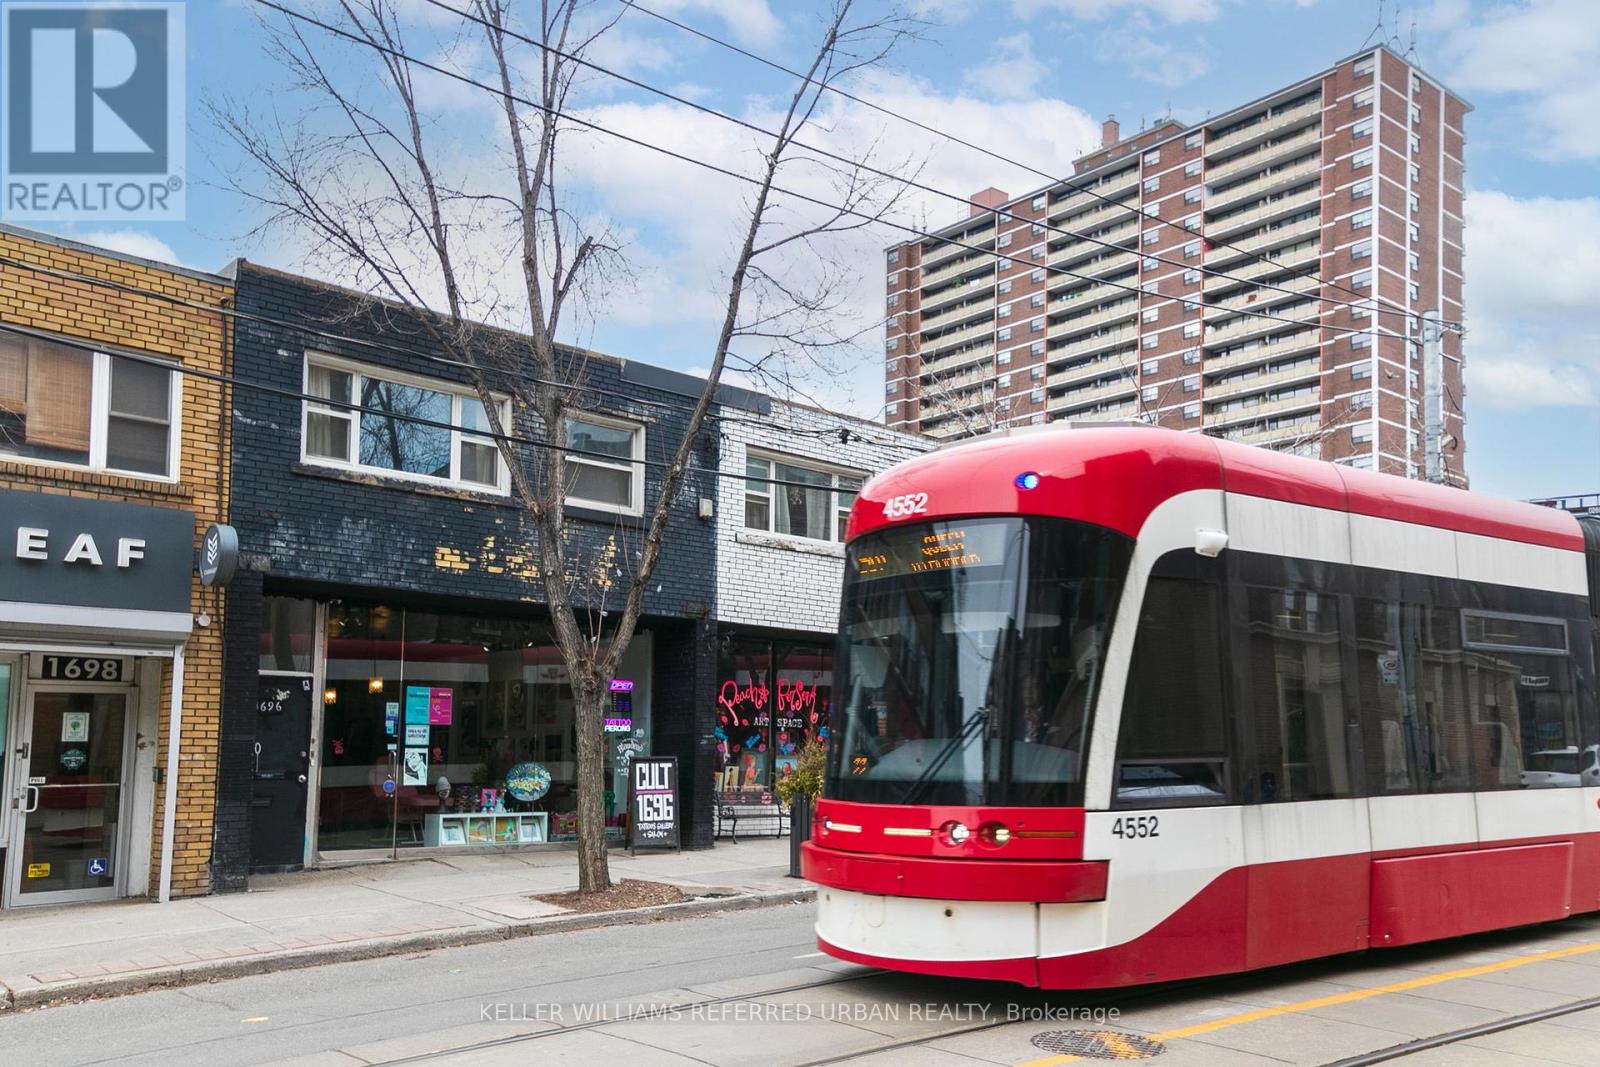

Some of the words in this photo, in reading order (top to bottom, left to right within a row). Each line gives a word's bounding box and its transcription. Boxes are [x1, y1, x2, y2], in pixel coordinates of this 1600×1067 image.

[882, 492, 928, 517] 4552
[48, 656, 118, 680] 1698
[609, 680, 633, 690] OPEN
[753, 717, 769, 726] ART
[777, 718, 803, 728] SPACE
[635, 763, 673, 790] CULT
[636, 793, 674, 822] 1696
[1111, 816, 1160, 839] 4552
